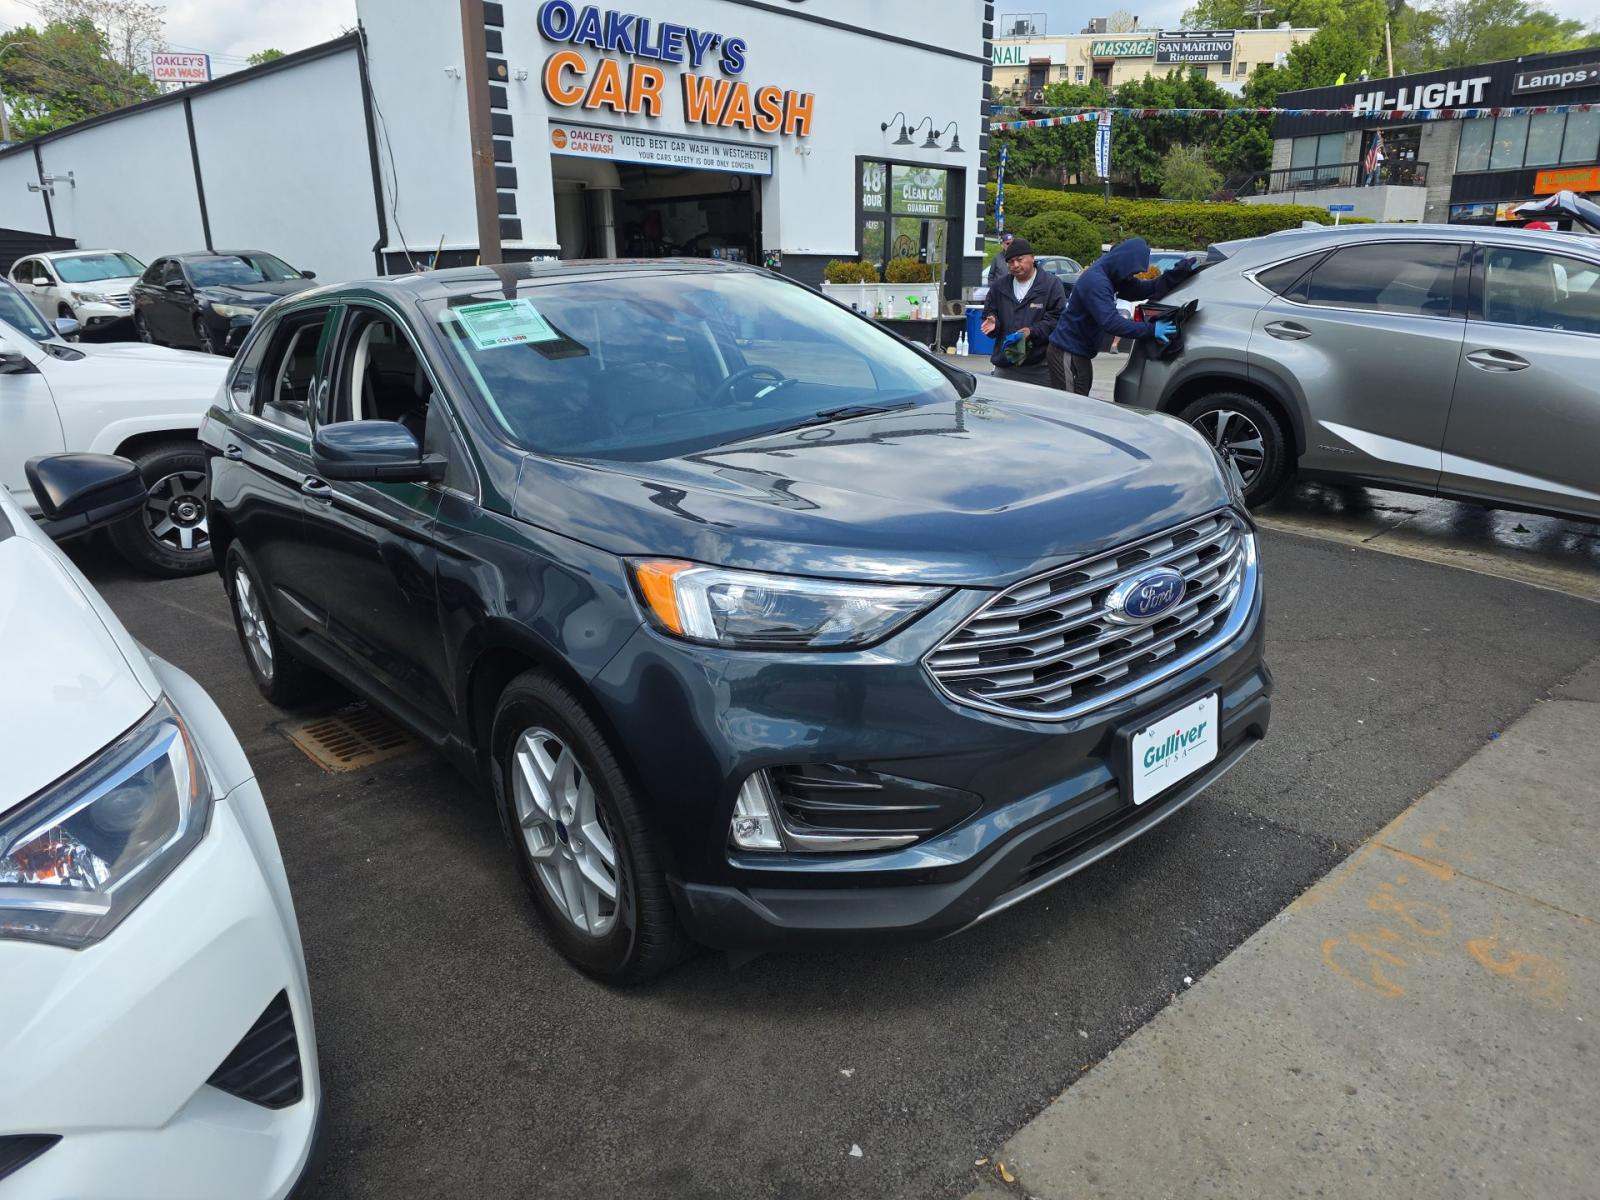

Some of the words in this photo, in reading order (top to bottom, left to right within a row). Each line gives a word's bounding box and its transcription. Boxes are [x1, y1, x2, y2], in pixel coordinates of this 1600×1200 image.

[537, 0, 747, 75] OAKLEY'S
[1158, 41, 1181, 52] SAN
[1182, 40, 1233, 52] MARTINO
[993, 46, 1026, 64] NAIL
[1094, 41, 1153, 55] MASSAGE
[1169, 52, 1219, 62] Ristorante
[155, 56, 204, 67] OAKLEY'S
[157, 67, 176, 77] CAR
[178, 68, 206, 78] WASH
[1518, 70, 1587, 89] Lamps
[542, 50, 665, 117] CAR
[681, 72, 815, 137] WASH
[1352, 76, 1492, 118] HI-LIGHT
[570, 130, 614, 143] OAKLEY'S
[571, 141, 588, 152] CAR
[590, 144, 614, 154] WASH
[620, 135, 646, 148] VOTED
[649, 138, 668, 150] BEST
[671, 141, 686, 152] CAR
[689, 143, 709, 155] WASH
[712, 146, 720, 155] IN
[723, 147, 769, 161] WESTCHESTER
[638, 151, 654, 160] YOUR
[656, 153, 672, 162] CARS
[674, 155, 694, 164] SAFETY
[704, 158, 714, 166] OUR
[717, 159, 729, 167] ONLY
[731, 161, 755, 170] CONCERN
[863, 167, 882, 192] 48
[903, 184, 927, 200] CLEAN
[928, 188, 944, 201] CAR
[907, 203, 939, 213] GUARANTEE
[1139, 580, 1175, 612] Ford
[1143, 720, 1208, 769] Gulliver
[1164, 748, 1189, 767] USA
